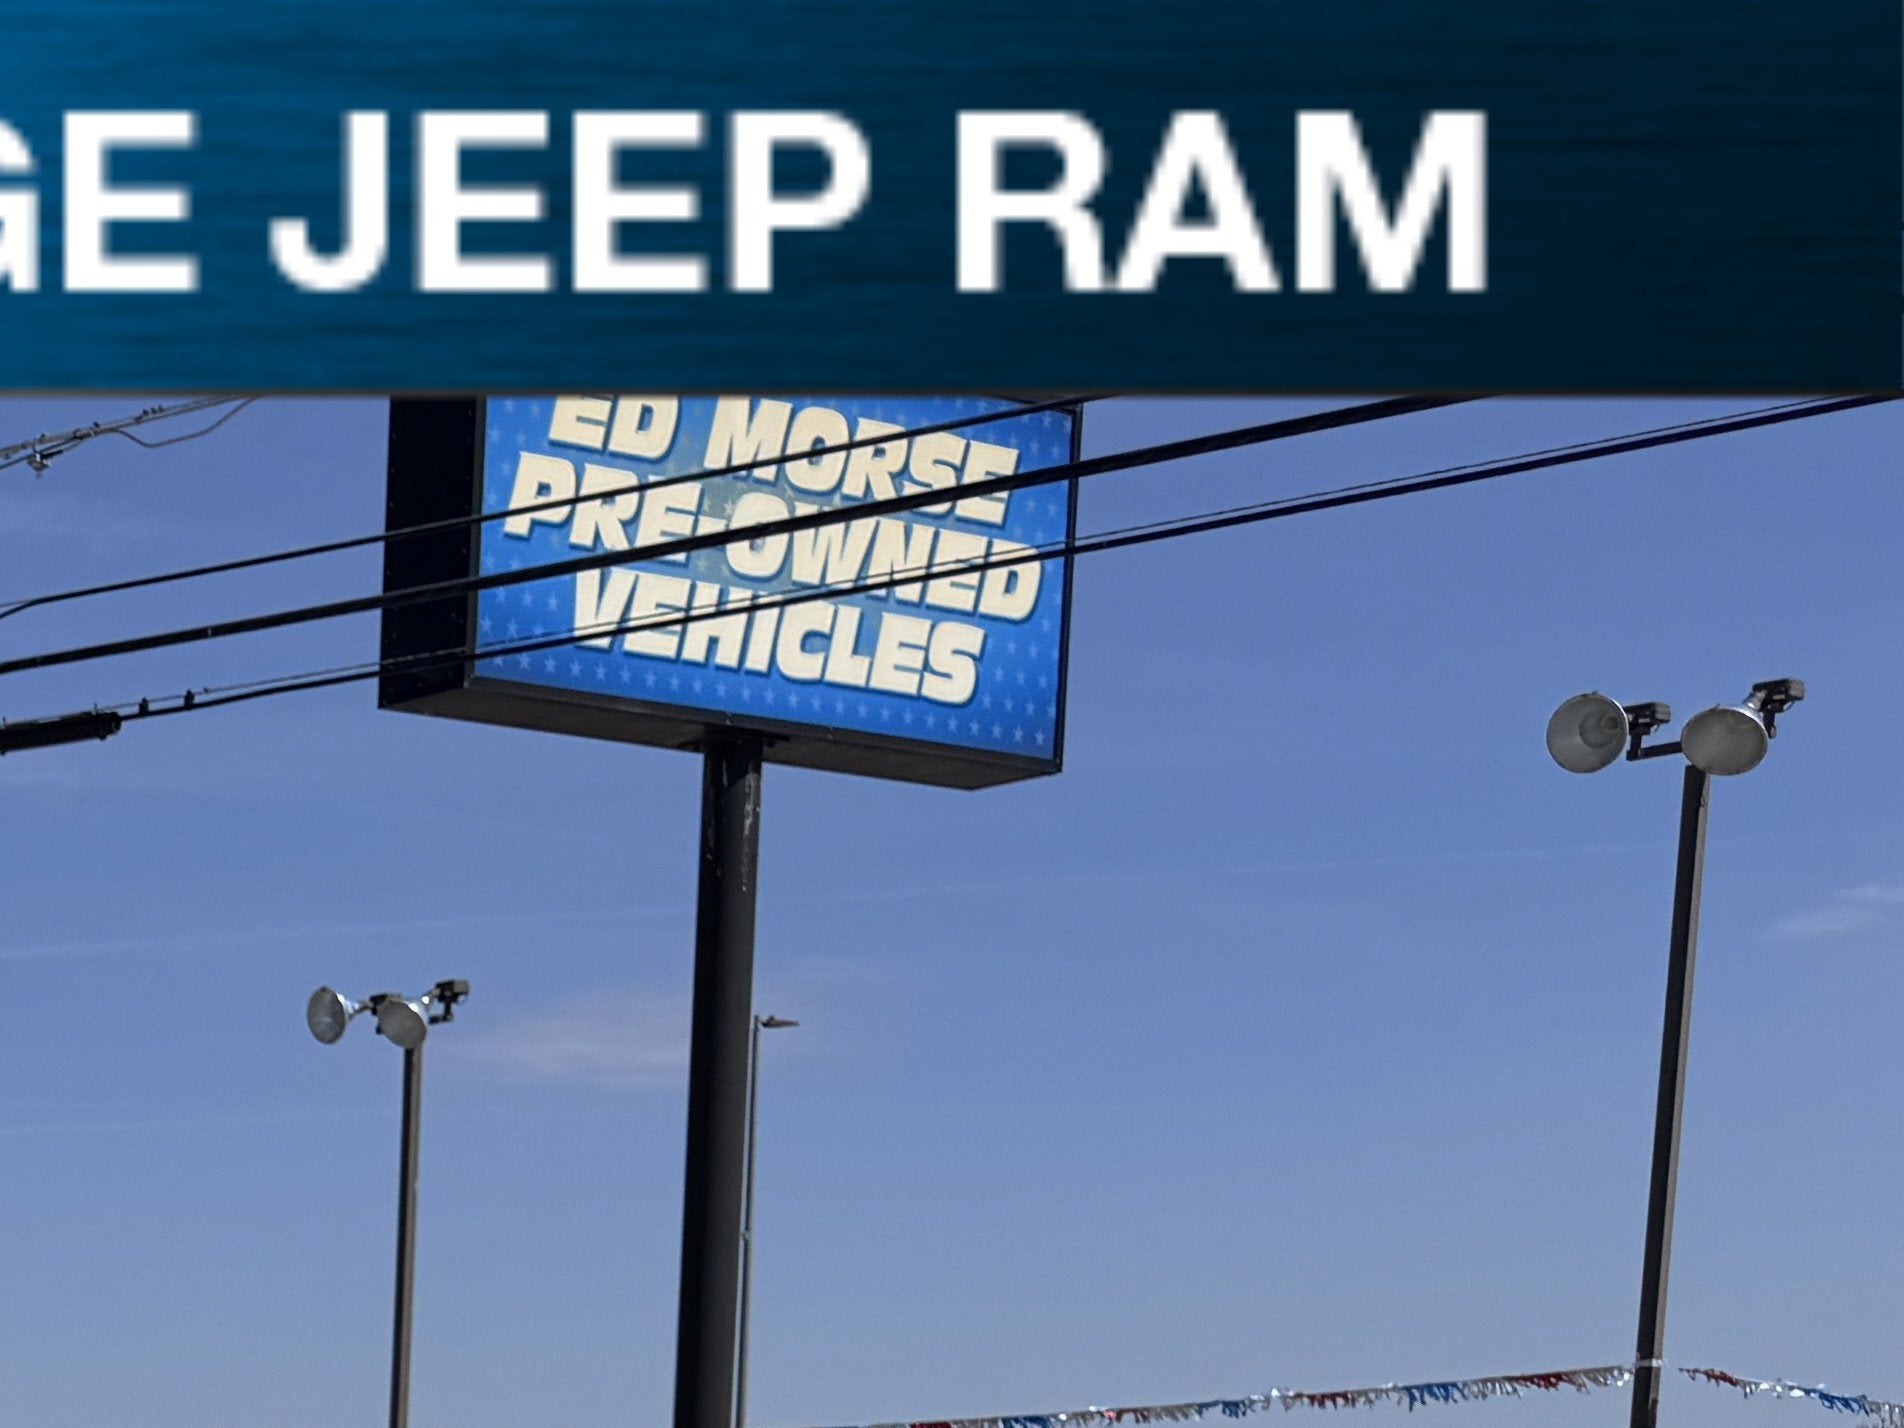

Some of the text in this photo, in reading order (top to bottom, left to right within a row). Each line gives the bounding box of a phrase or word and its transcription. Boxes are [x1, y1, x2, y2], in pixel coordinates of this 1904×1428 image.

[548, 395, 1021, 527] ED MORSE
[503, 451, 1042, 623] PRE-OWNED
[571, 569, 987, 705] VEHICLES
